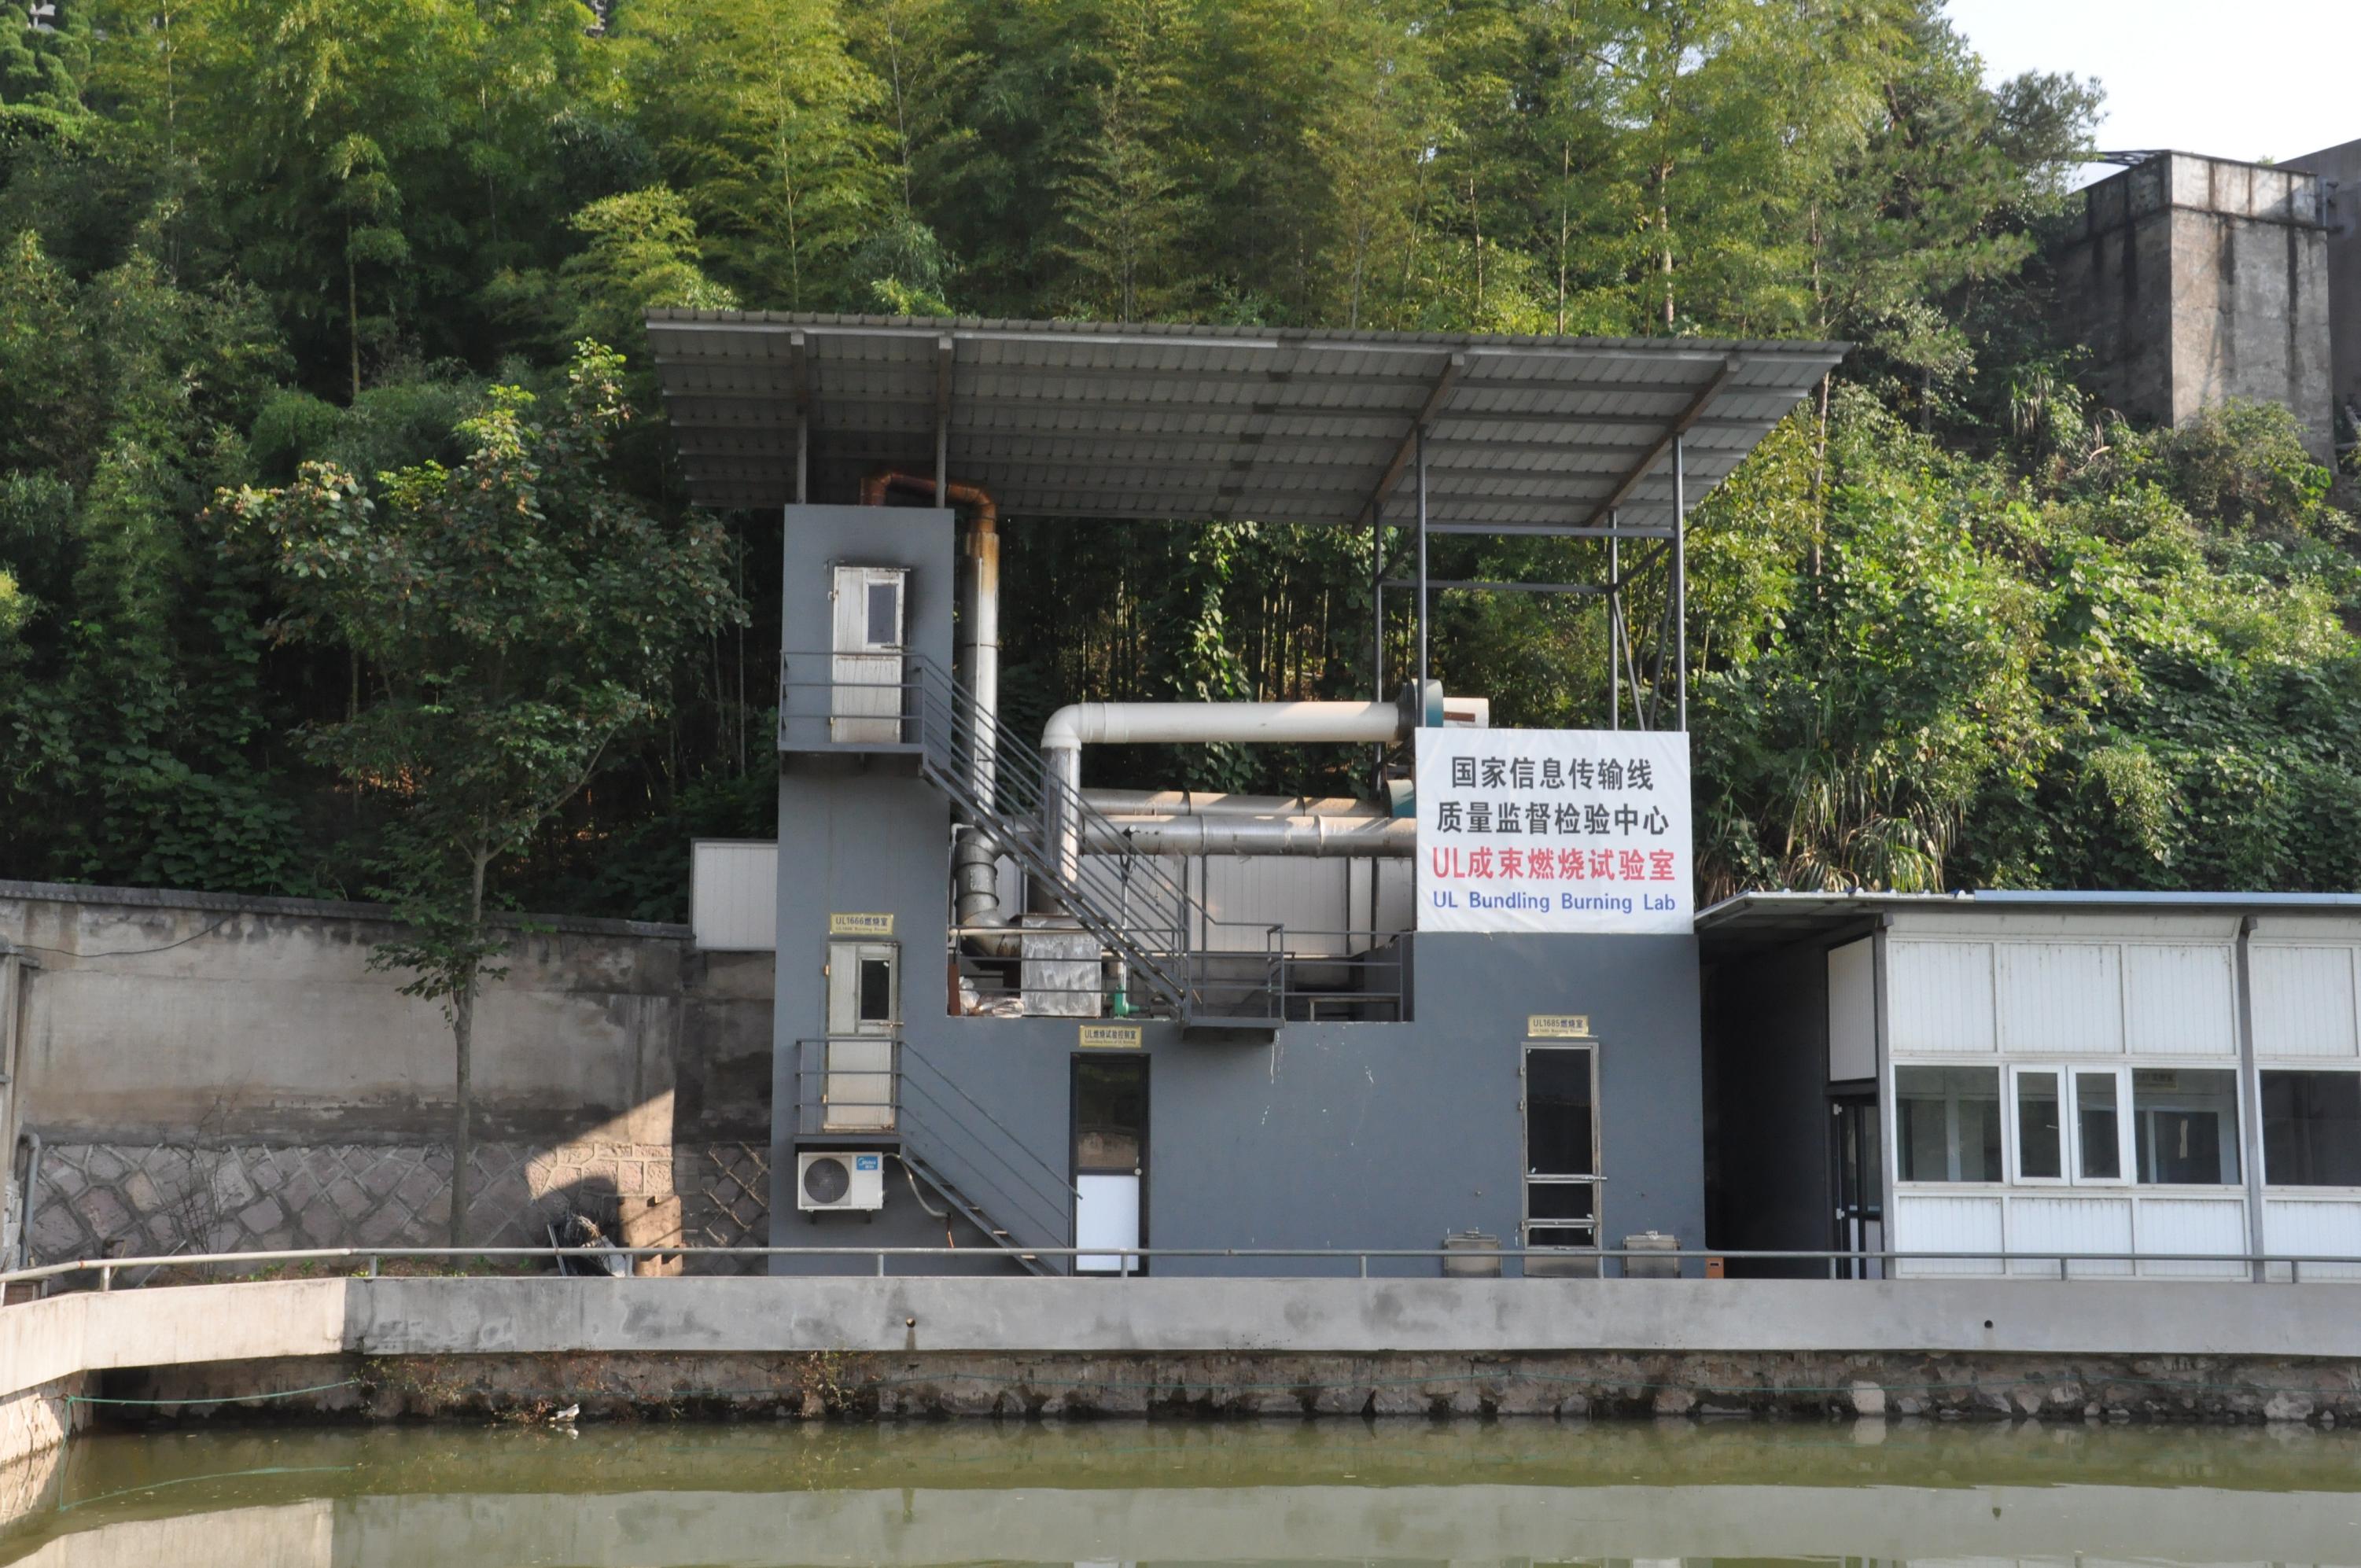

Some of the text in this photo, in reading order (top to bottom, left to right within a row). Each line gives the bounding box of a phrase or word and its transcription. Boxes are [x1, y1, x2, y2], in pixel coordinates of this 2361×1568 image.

[1451, 756, 1654, 791] 国家信息传输线
[1436, 801, 1670, 836] 质量监督检验中心
[1432, 845, 1675, 882] UL成束燃烧试验室
[1433, 891, 1676, 914] UL Bundling Burning Lab
